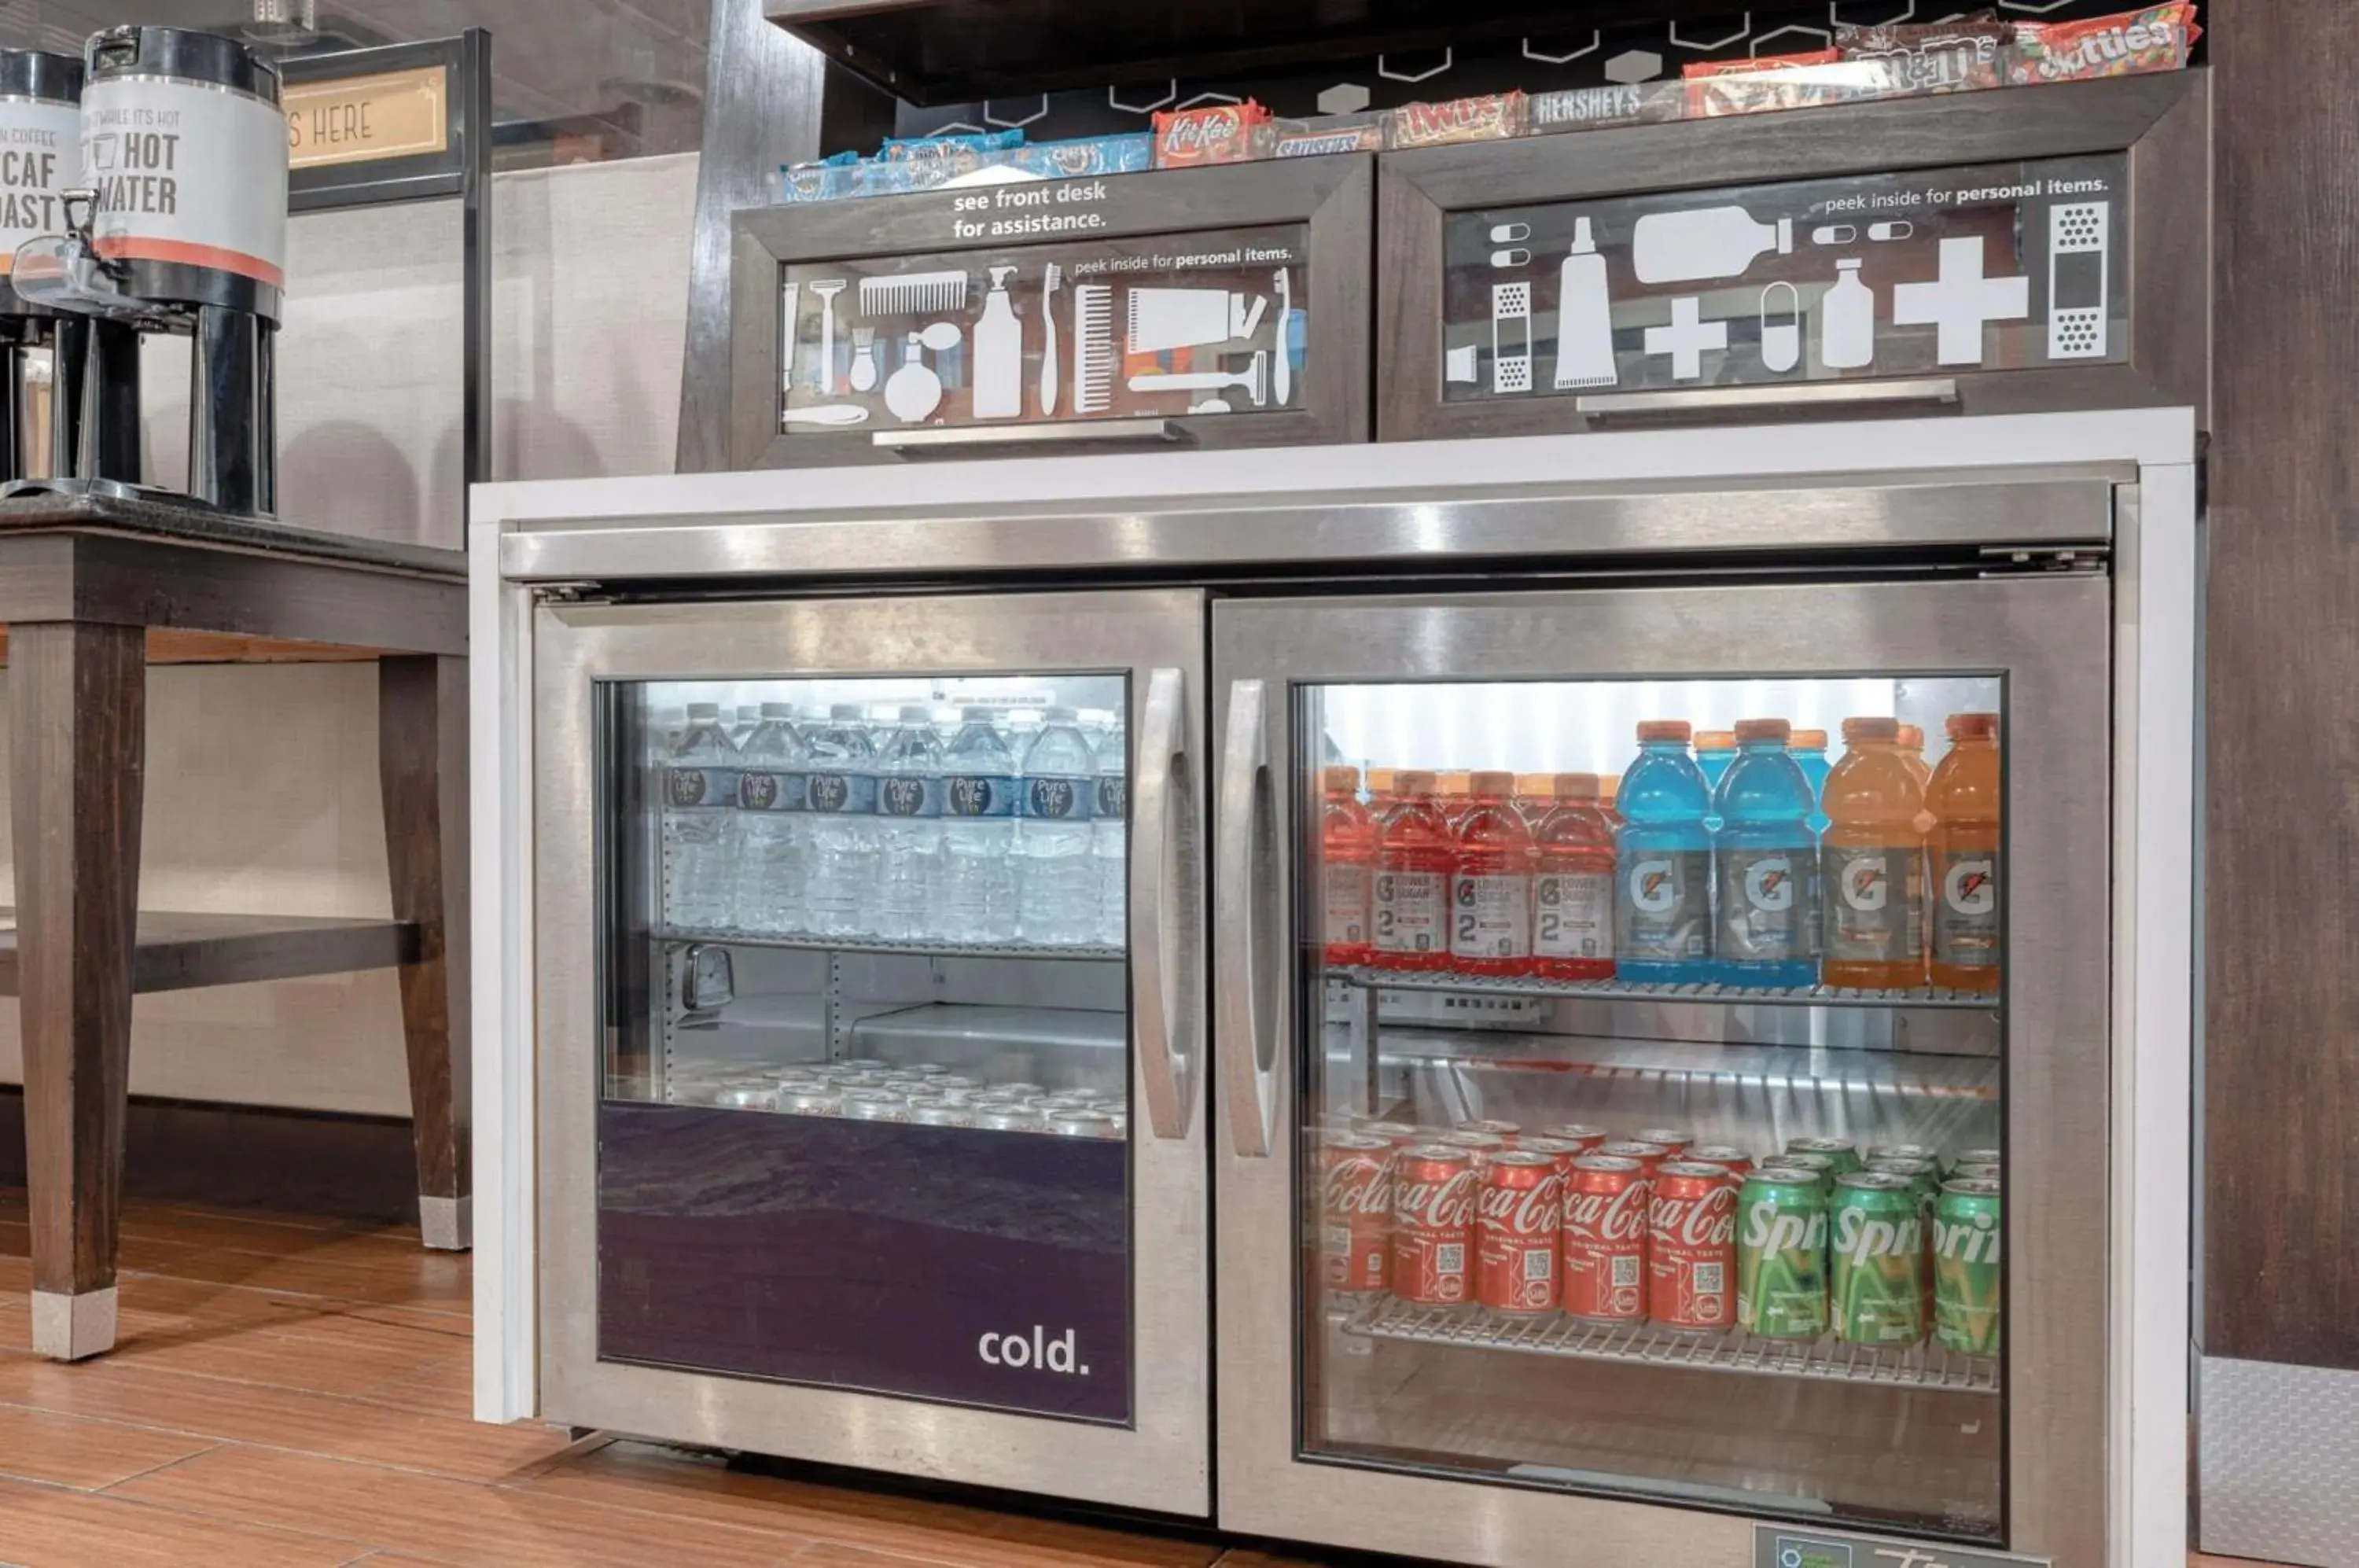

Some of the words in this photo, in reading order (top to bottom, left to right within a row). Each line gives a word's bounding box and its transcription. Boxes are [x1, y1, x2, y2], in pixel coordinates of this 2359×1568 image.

[157, 111, 182, 128] HOT
[313, 101, 374, 145] HERE
[12, 127, 57, 148] COFFEE
[124, 132, 180, 171] HOT
[2, 150, 57, 189] CAF
[98, 175, 177, 215] WATER
[954, 195, 989, 212] see
[995, 187, 1050, 208] front
[1057, 180, 1107, 202] desk
[1825, 196, 1866, 215] peek
[1871, 192, 1921, 208] inside
[1927, 188, 1952, 204] for
[1956, 180, 2041, 204] personal
[2048, 178, 2109, 194] items.
[0, 193, 56, 231] AST
[954, 219, 985, 239] for
[991, 212, 1107, 234] assistance.
[1075, 259, 1107, 276] peek
[1111, 256, 1149, 271] inside
[1153, 254, 1172, 268] for
[1176, 249, 1241, 270] personal
[1246, 248, 1293, 262] items.
[672, 769, 701, 782] Pure
[744, 772, 772, 786] Pure
[814, 775, 841, 787] Pure
[889, 778, 918, 790] Pure
[956, 777, 984, 790] Pure
[1037, 778, 1067, 792] Pure
[1104, 777, 1125, 790] Pur
[1106, 788, 1125, 803] Lif
[1630, 859, 1673, 912] G
[1745, 856, 1793, 911] G
[1842, 856, 1887, 911] G
[1945, 859, 1994, 915] G
[1378, 910, 1394, 936] 2
[1459, 914, 1476, 941] 2
[1541, 913, 1560, 940] 2
[979, 1324, 1090, 1375] cold.
